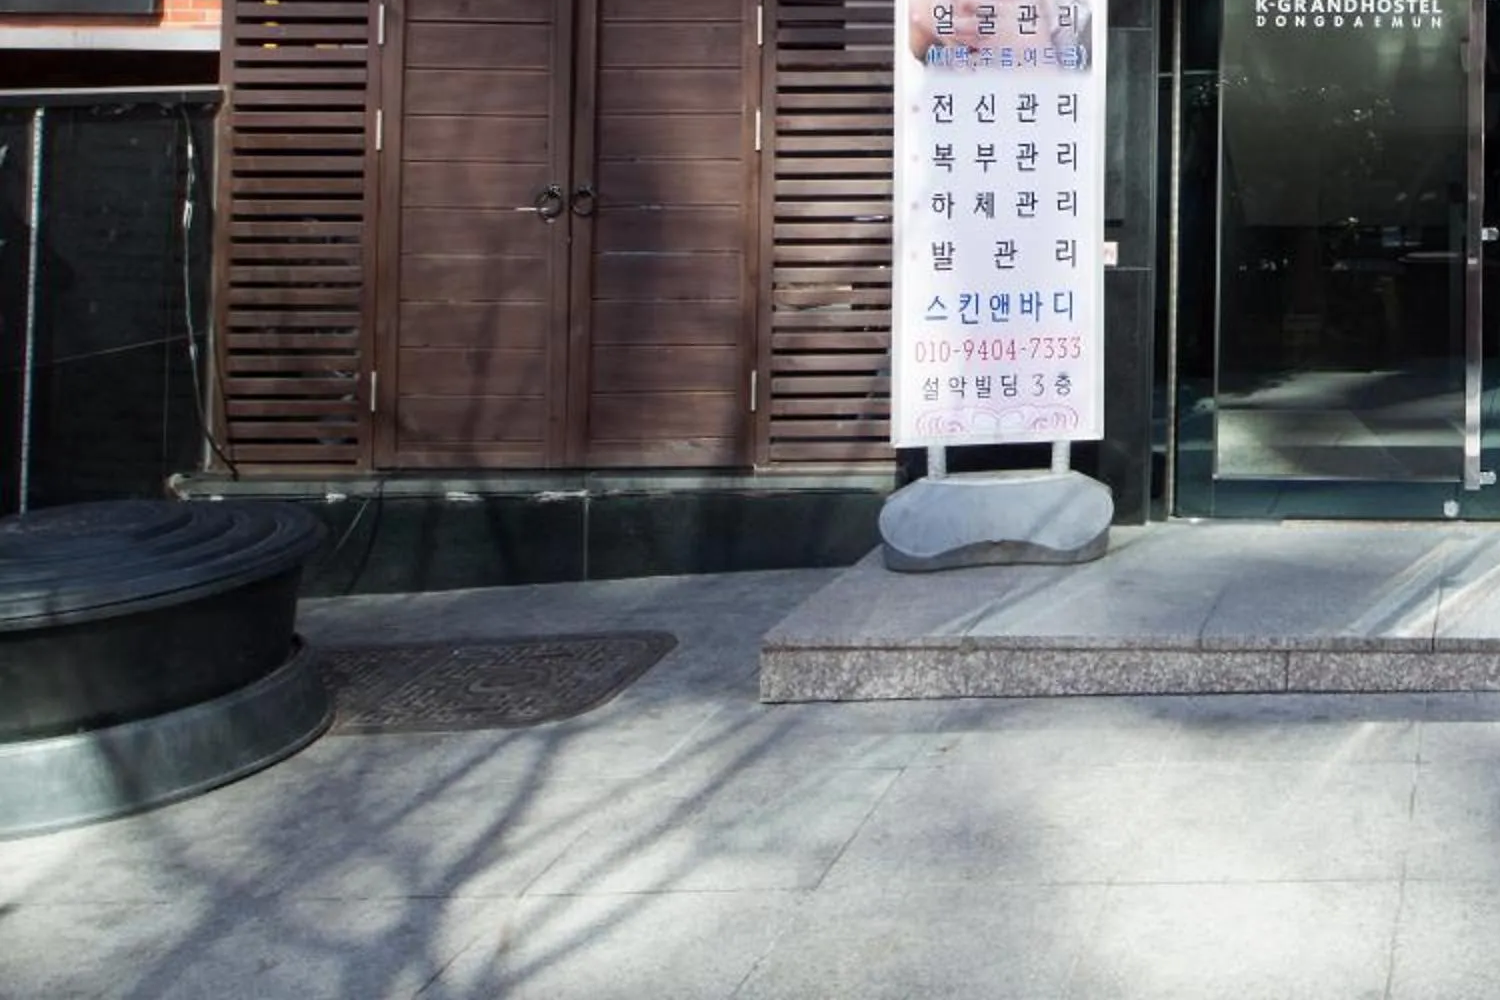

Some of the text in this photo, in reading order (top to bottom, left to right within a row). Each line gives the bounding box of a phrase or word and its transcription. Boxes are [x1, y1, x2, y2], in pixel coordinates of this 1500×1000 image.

[933, 4, 1078, 35] 얼굴관리
[1257, 16, 1442, 27] DONGDAEMUN
[932, 93, 1078, 122] 전신관리
[933, 142, 1078, 172] 복부관리
[932, 190, 1078, 219] 하체관리
[925, 290, 1074, 324] 스킨앤바디
[916, 337, 1082, 364] 010-9404-7333
[923, 373, 1073, 400] 설악빌딩 3층
